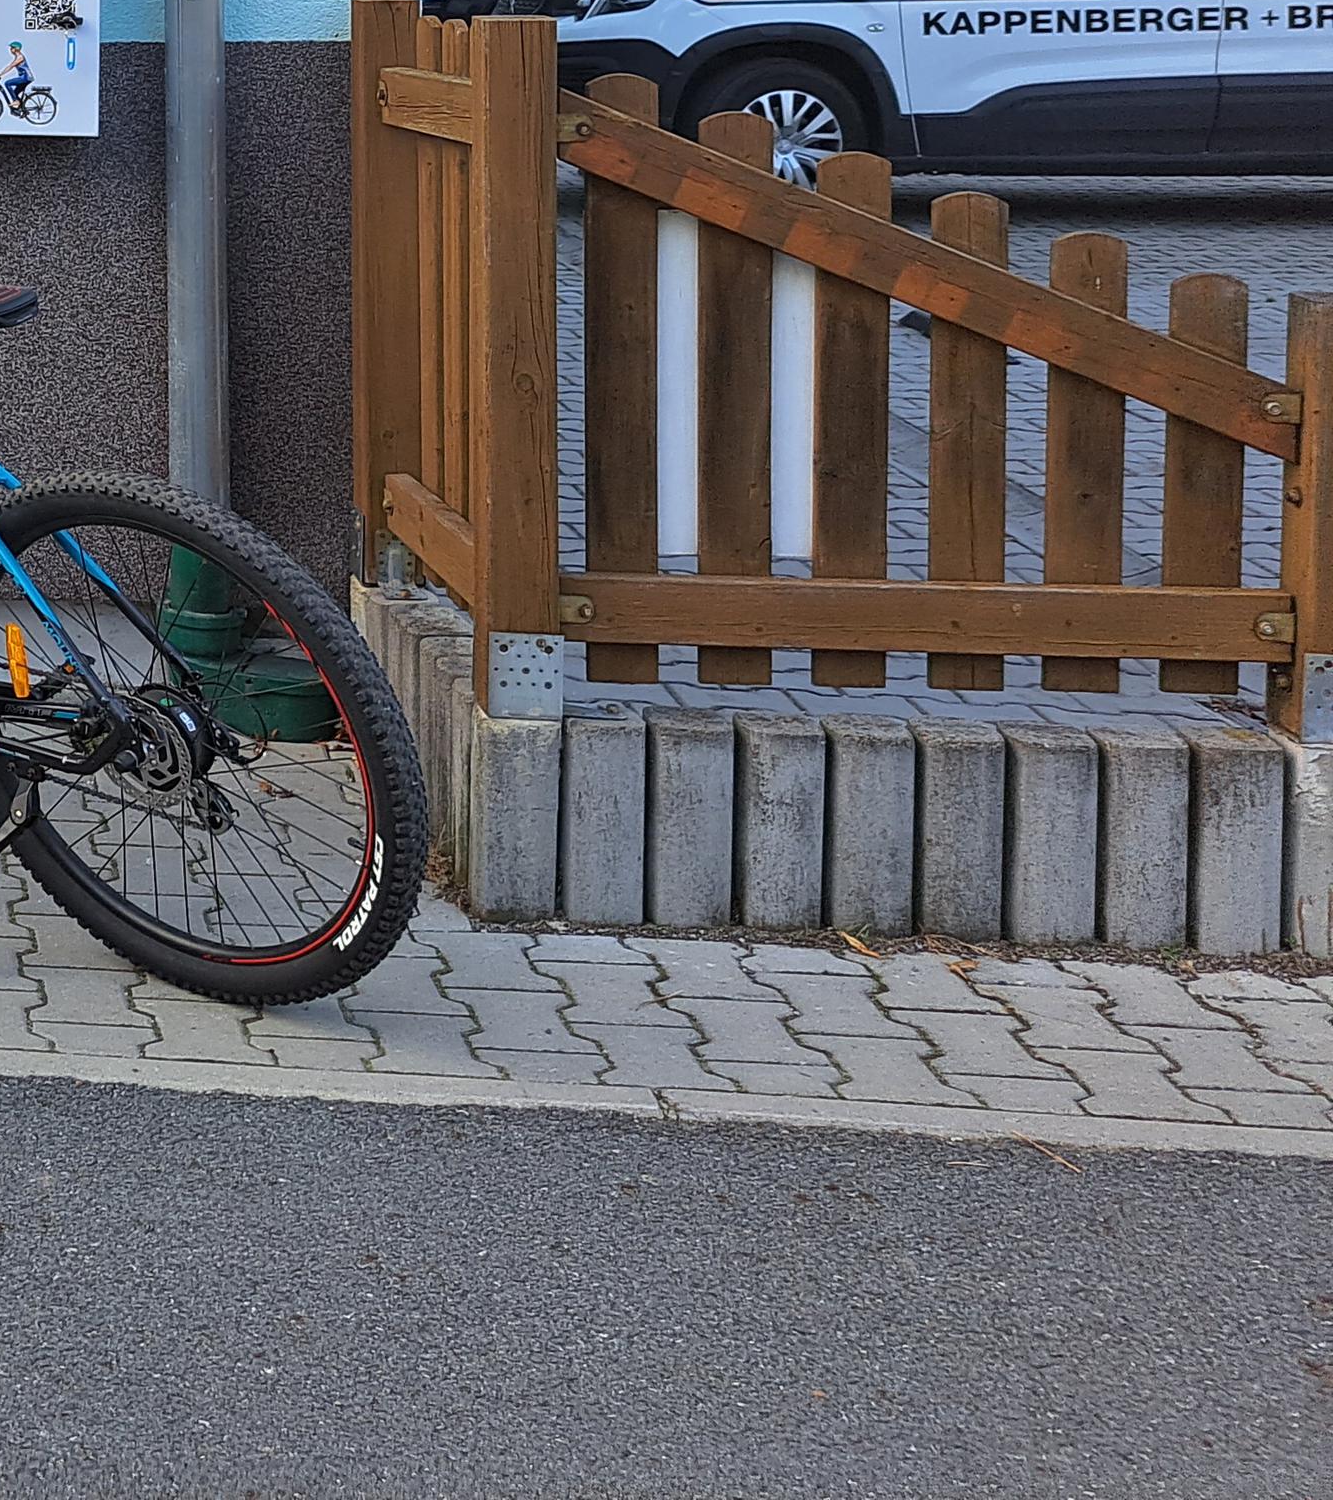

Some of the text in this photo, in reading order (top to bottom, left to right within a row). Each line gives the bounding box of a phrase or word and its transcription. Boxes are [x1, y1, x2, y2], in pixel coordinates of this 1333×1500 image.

[922, 4, 1333, 36] KAPPENBERGER + BR
[333, 878, 379, 952] PATROL
